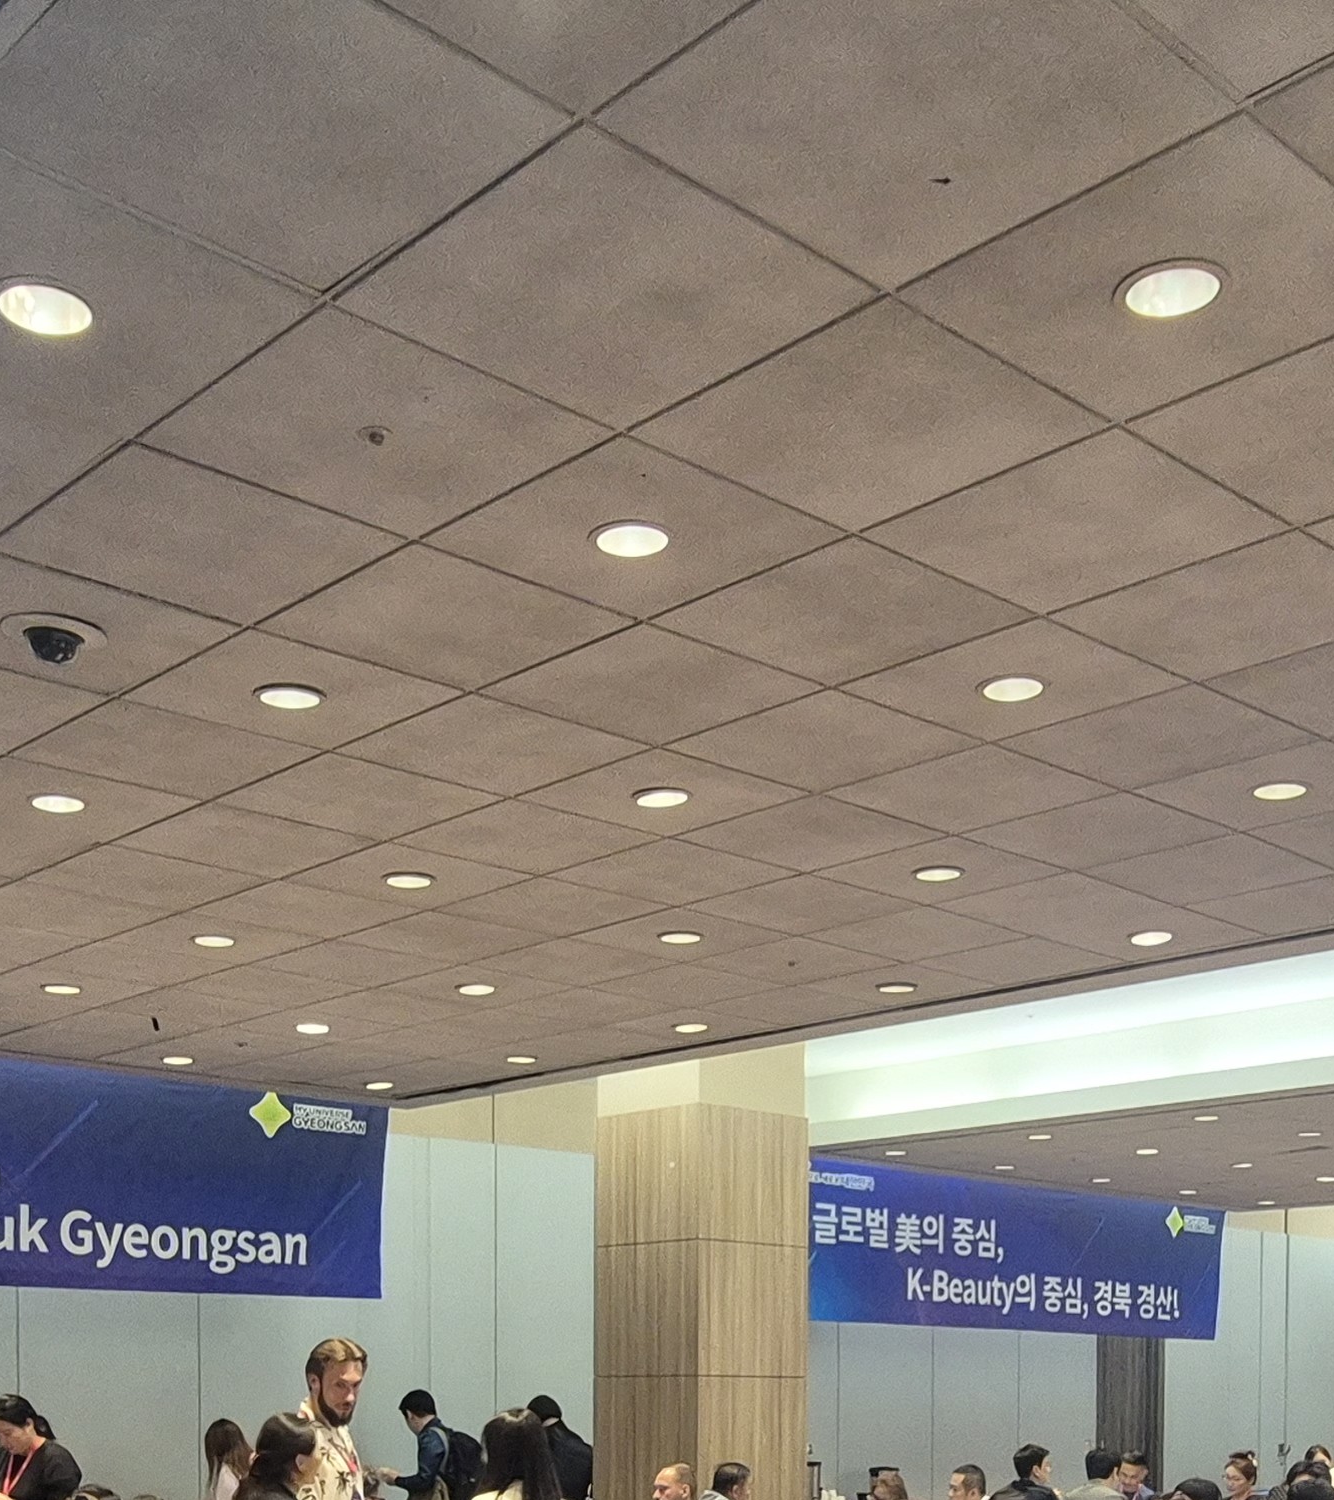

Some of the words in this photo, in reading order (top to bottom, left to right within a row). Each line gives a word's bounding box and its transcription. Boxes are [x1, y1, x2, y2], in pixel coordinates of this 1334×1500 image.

[293, 1117, 366, 1134] GYEONGSAN
[59, 1210, 309, 1275] Gyeongsan
[812, 1202, 890, 1249] 글로벌
[894, 1212, 945, 1256] 美의
[951, 1216, 1005, 1264] 중심,
[906, 1266, 1036, 1316] K-Beauty의
[1042, 1275, 1089, 1320] 중심,
[1093, 1279, 1133, 1320] 경북
[1136, 1284, 1181, 1321] 경산!
